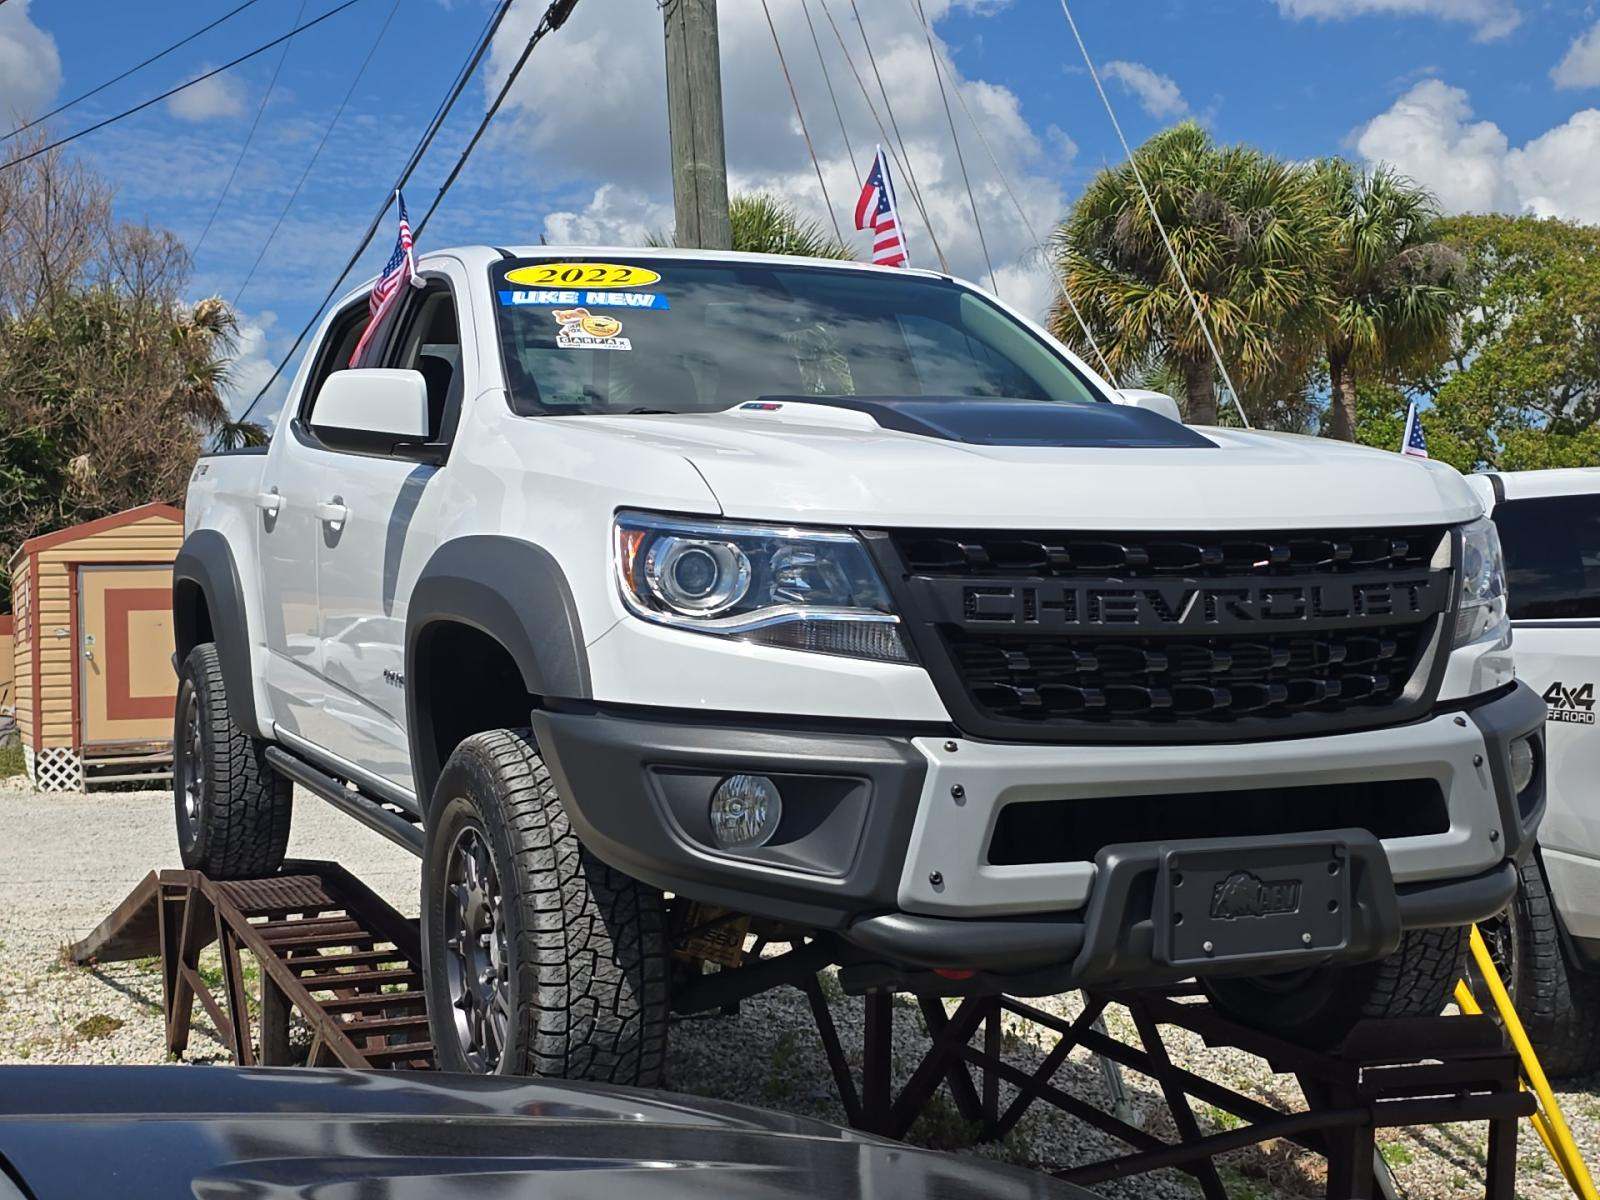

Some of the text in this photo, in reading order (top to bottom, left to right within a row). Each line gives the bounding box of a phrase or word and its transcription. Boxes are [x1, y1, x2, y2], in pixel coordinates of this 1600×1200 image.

[535, 268, 633, 283] 2022
[512, 291, 655, 307] LIKE NEW
[963, 579, 1431, 624] CHEVROLET
[1562, 711, 1594, 723] ROAD
